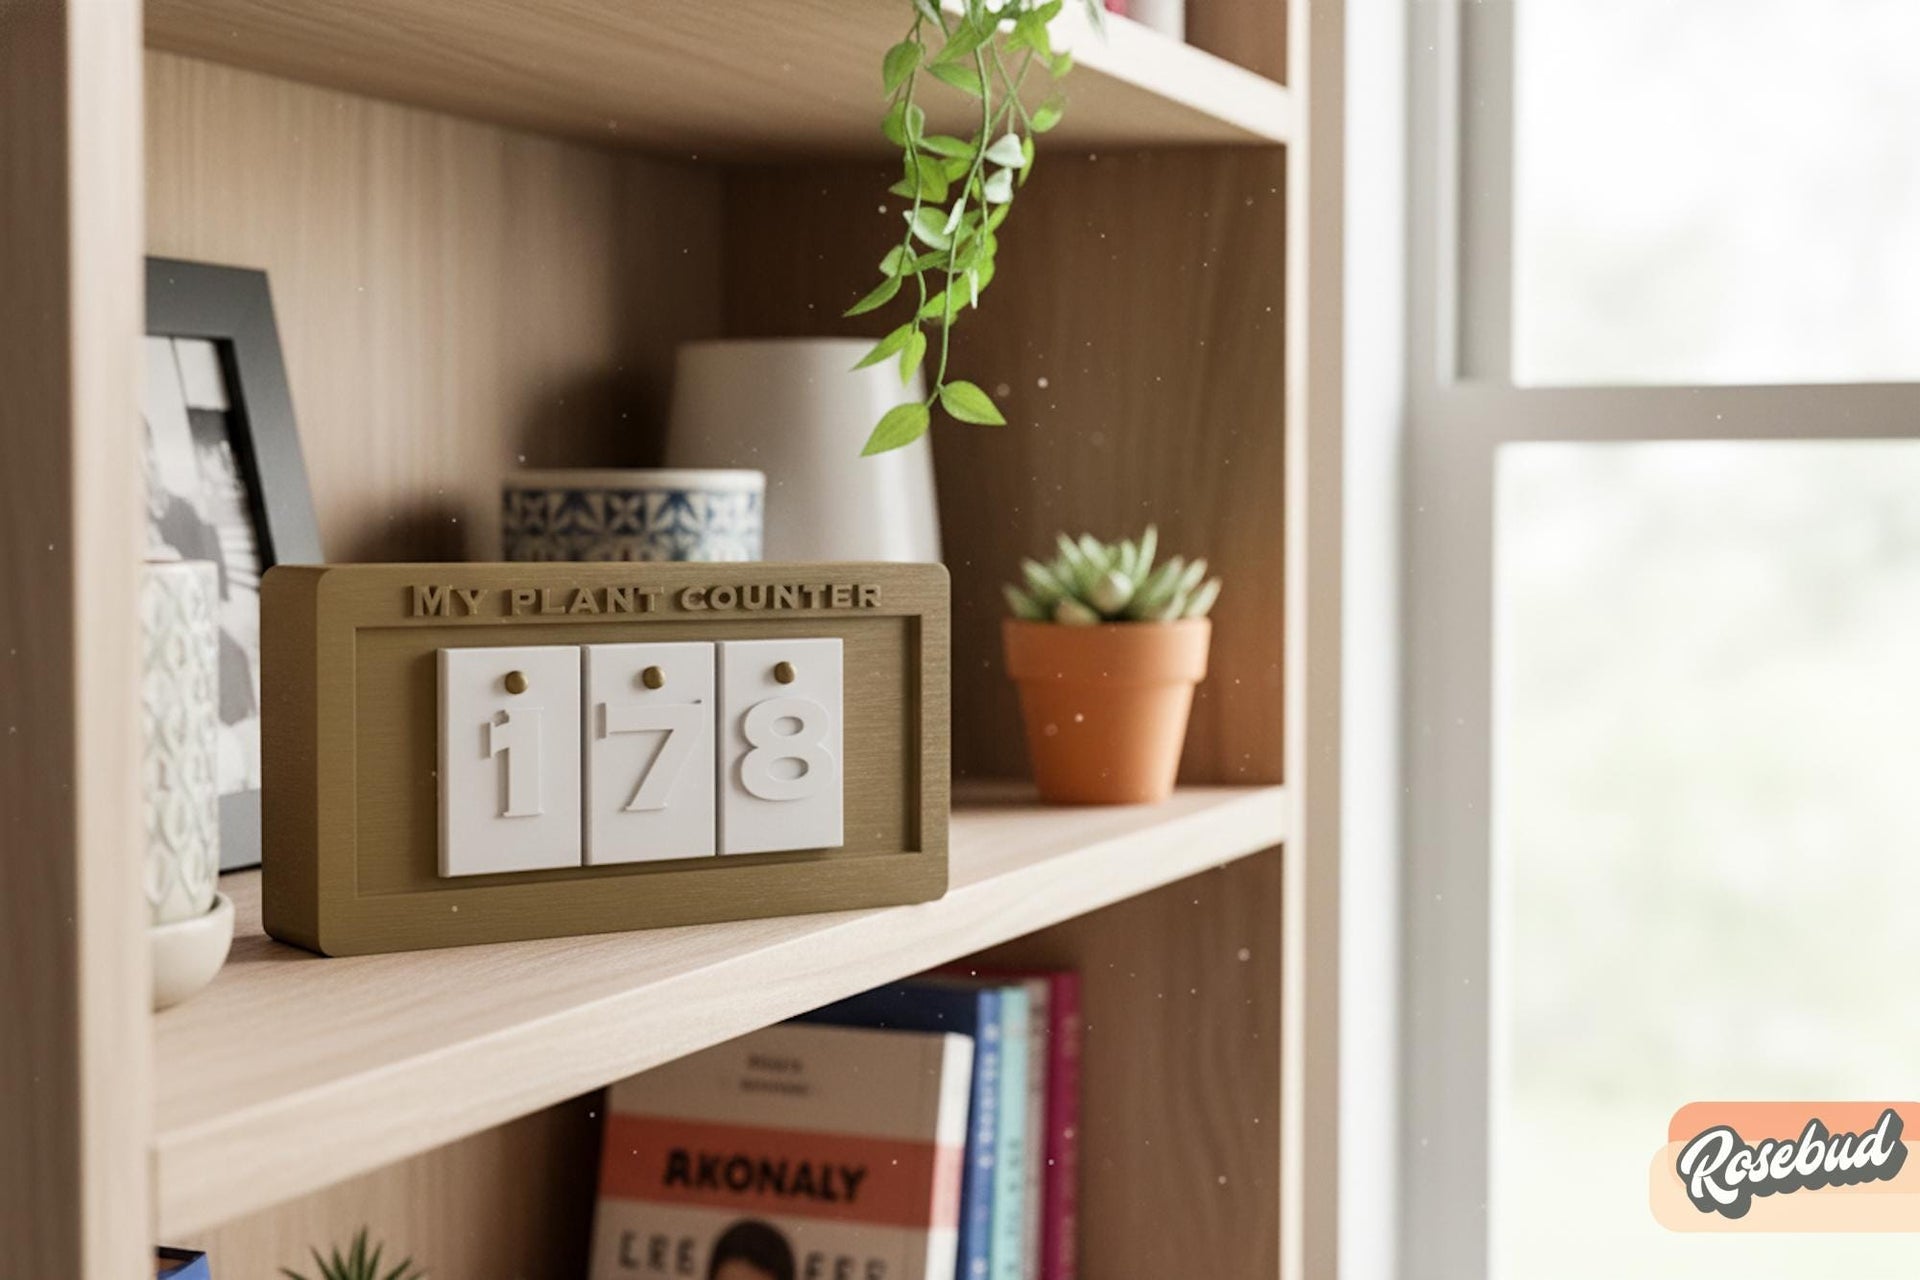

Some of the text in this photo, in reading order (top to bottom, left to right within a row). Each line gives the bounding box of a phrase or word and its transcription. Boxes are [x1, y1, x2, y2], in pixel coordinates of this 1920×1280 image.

[407, 583, 882, 616] MY PLANT COUNTER
